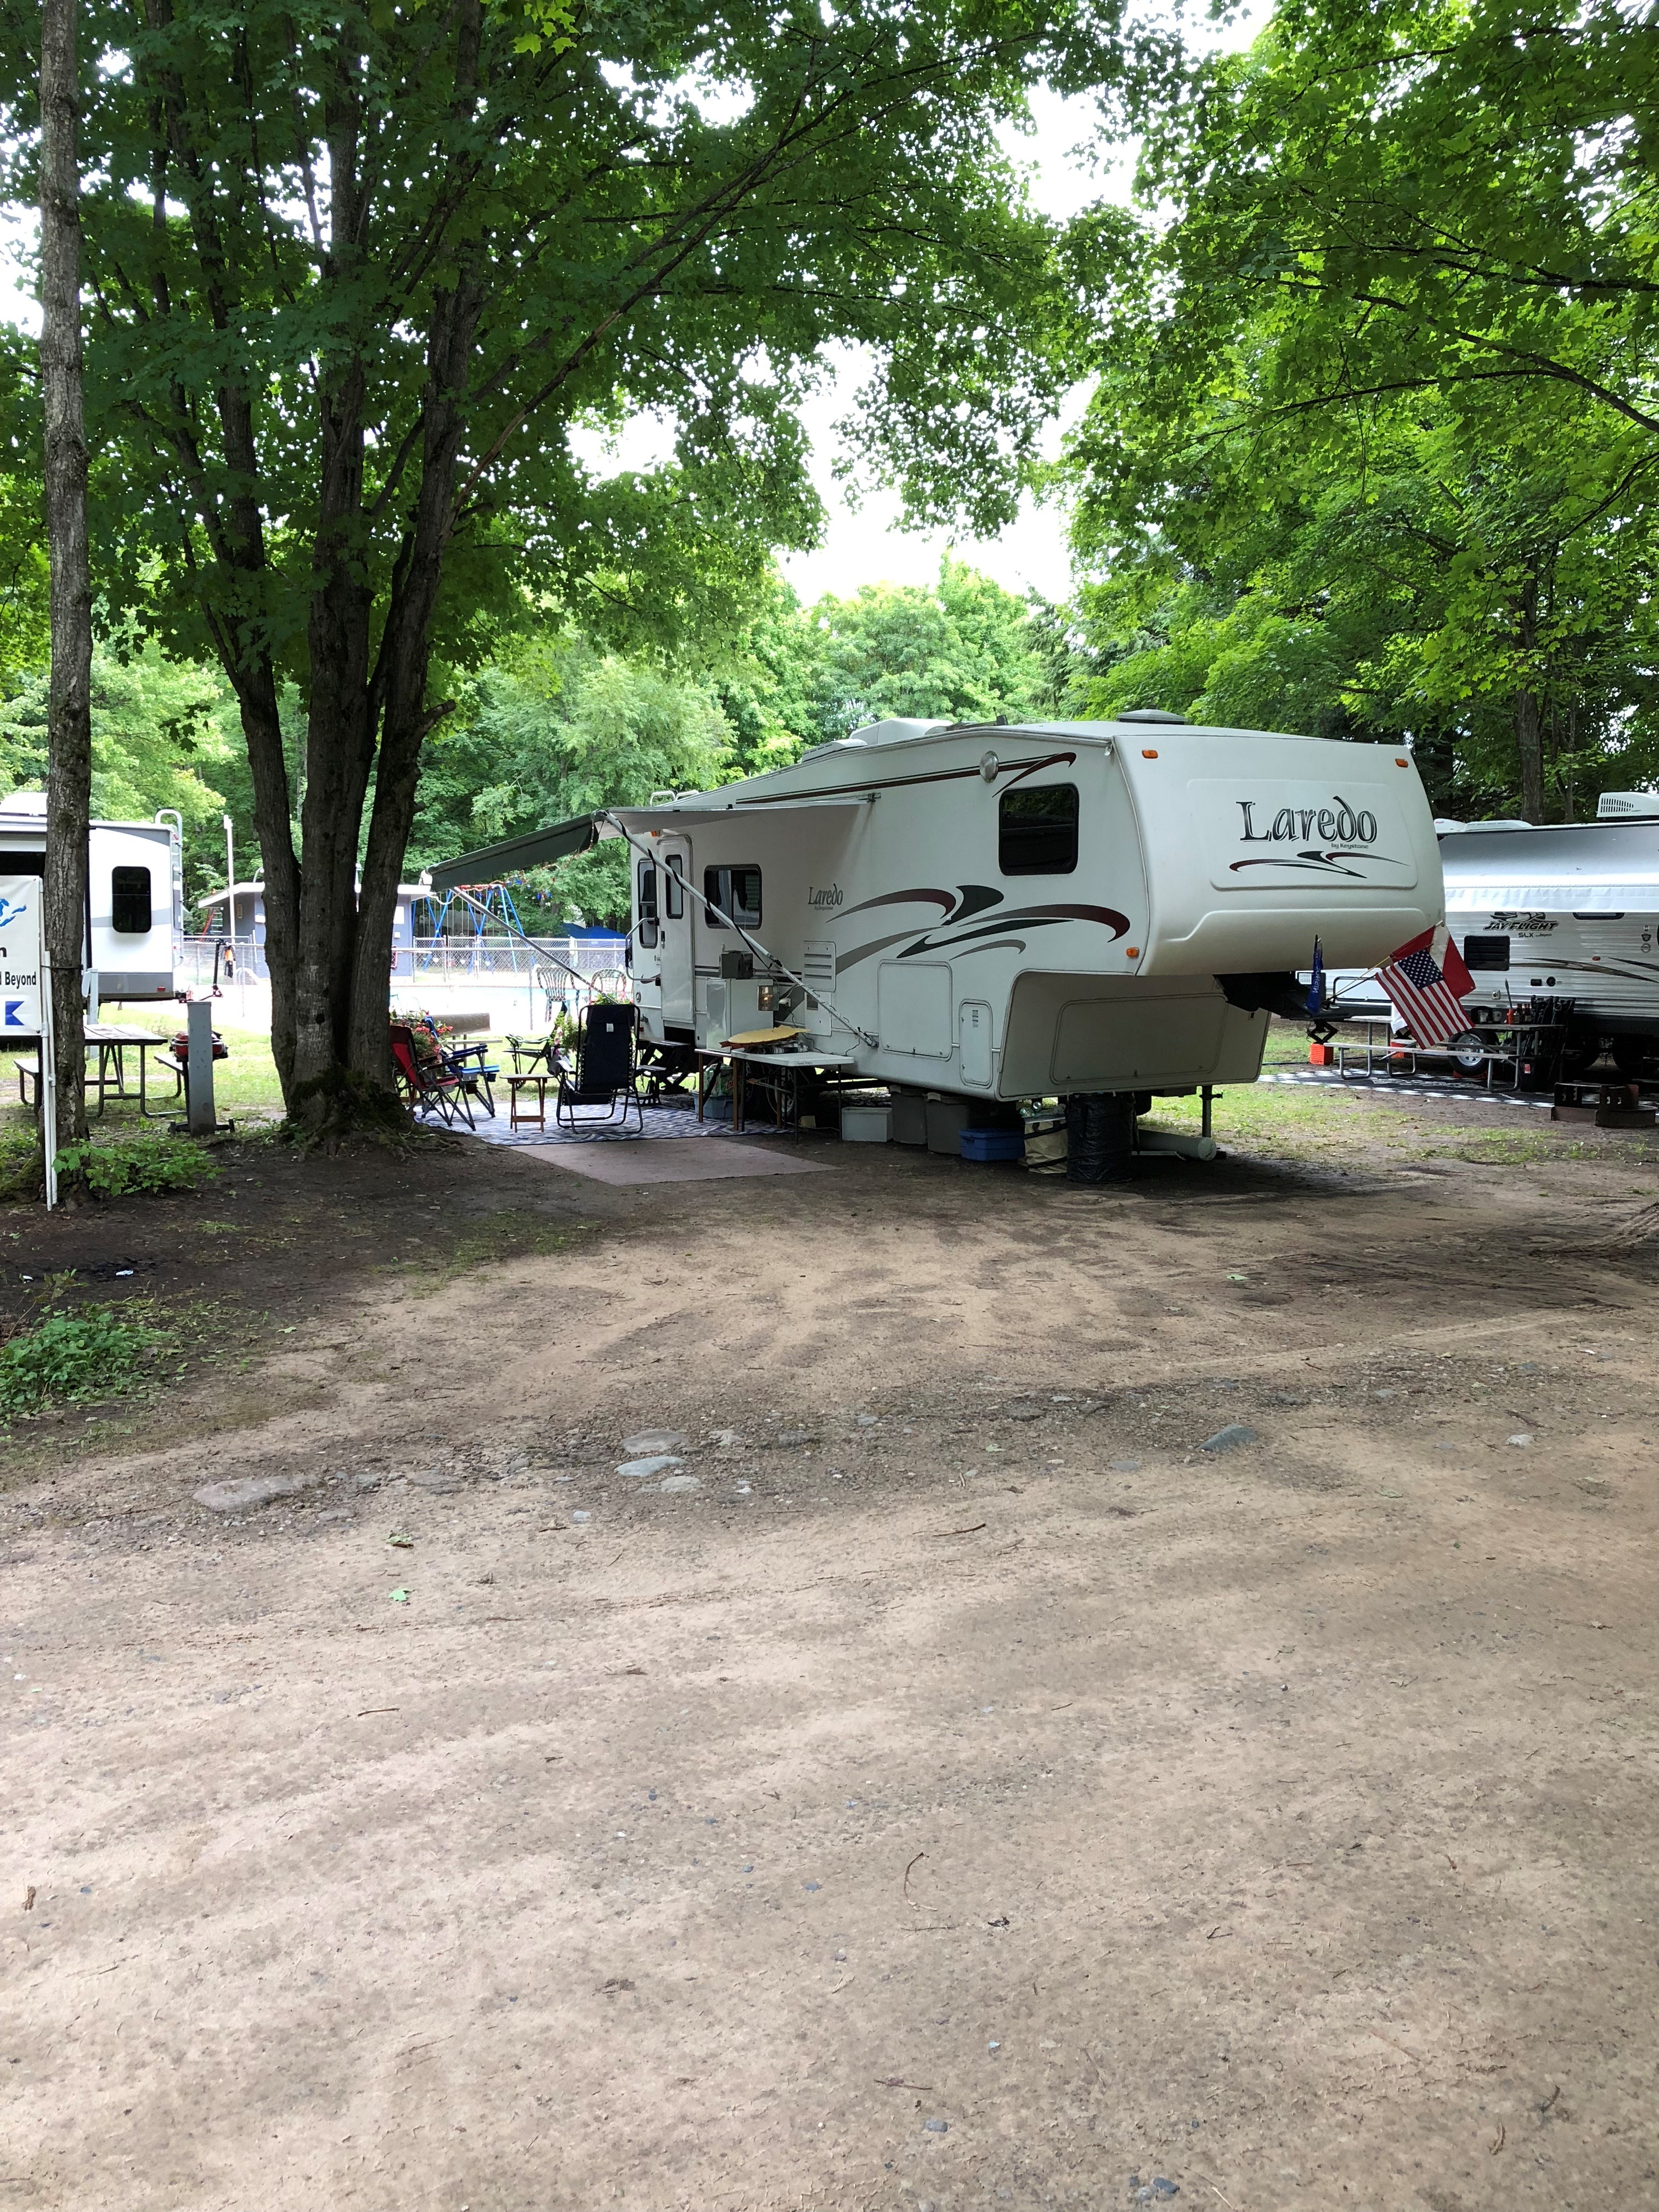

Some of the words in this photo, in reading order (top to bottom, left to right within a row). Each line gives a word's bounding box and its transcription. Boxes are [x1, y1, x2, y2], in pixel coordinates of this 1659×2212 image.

[1235, 795, 1378, 843] Laredo
[808, 883, 843, 905] Laredo
[1483, 921, 1509, 930] JAY
[1508, 922, 1559, 931] FLIGHT
[5, 972, 36, 989] Beyond
